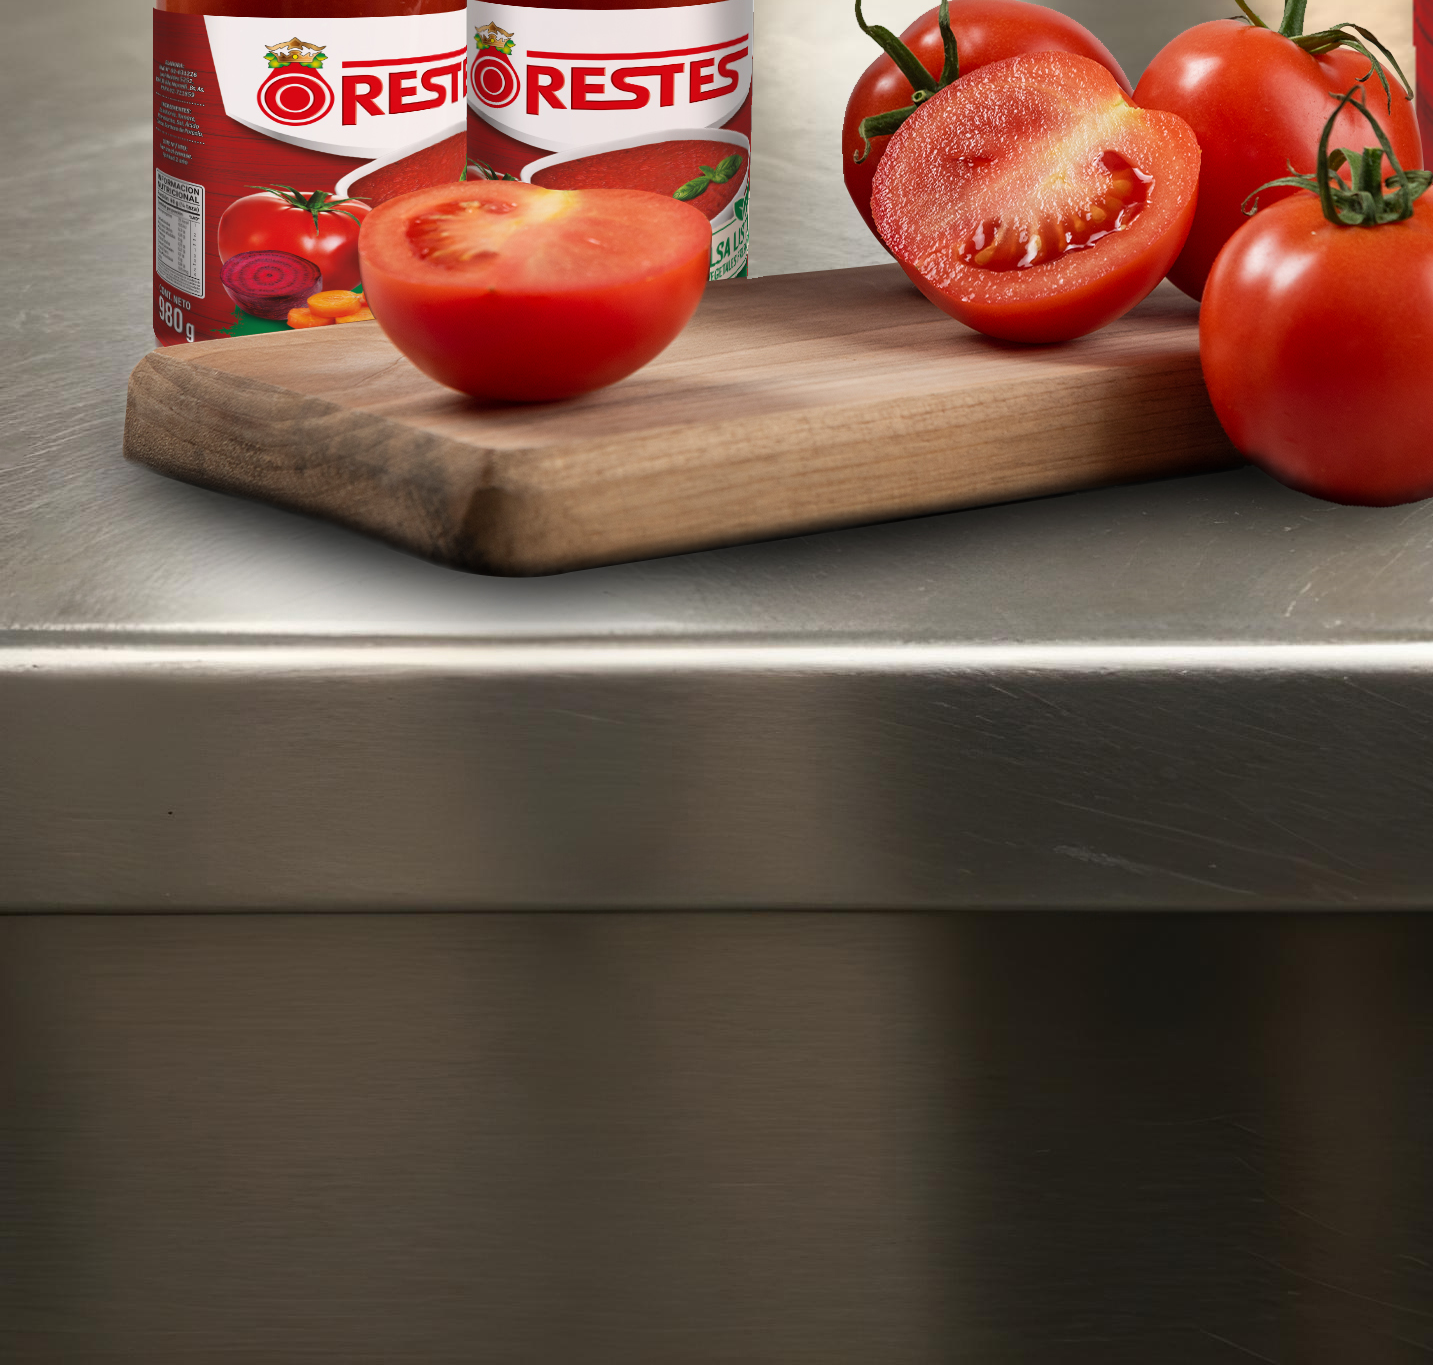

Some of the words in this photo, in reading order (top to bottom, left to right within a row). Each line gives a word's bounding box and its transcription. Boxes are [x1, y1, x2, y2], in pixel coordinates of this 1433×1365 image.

[257, 57, 467, 127] OREST
[470, 46, 749, 116] ORESTES
[159, 295, 183, 334] 980
[186, 322, 195, 343] g
[173, 295, 191, 311] NETO
